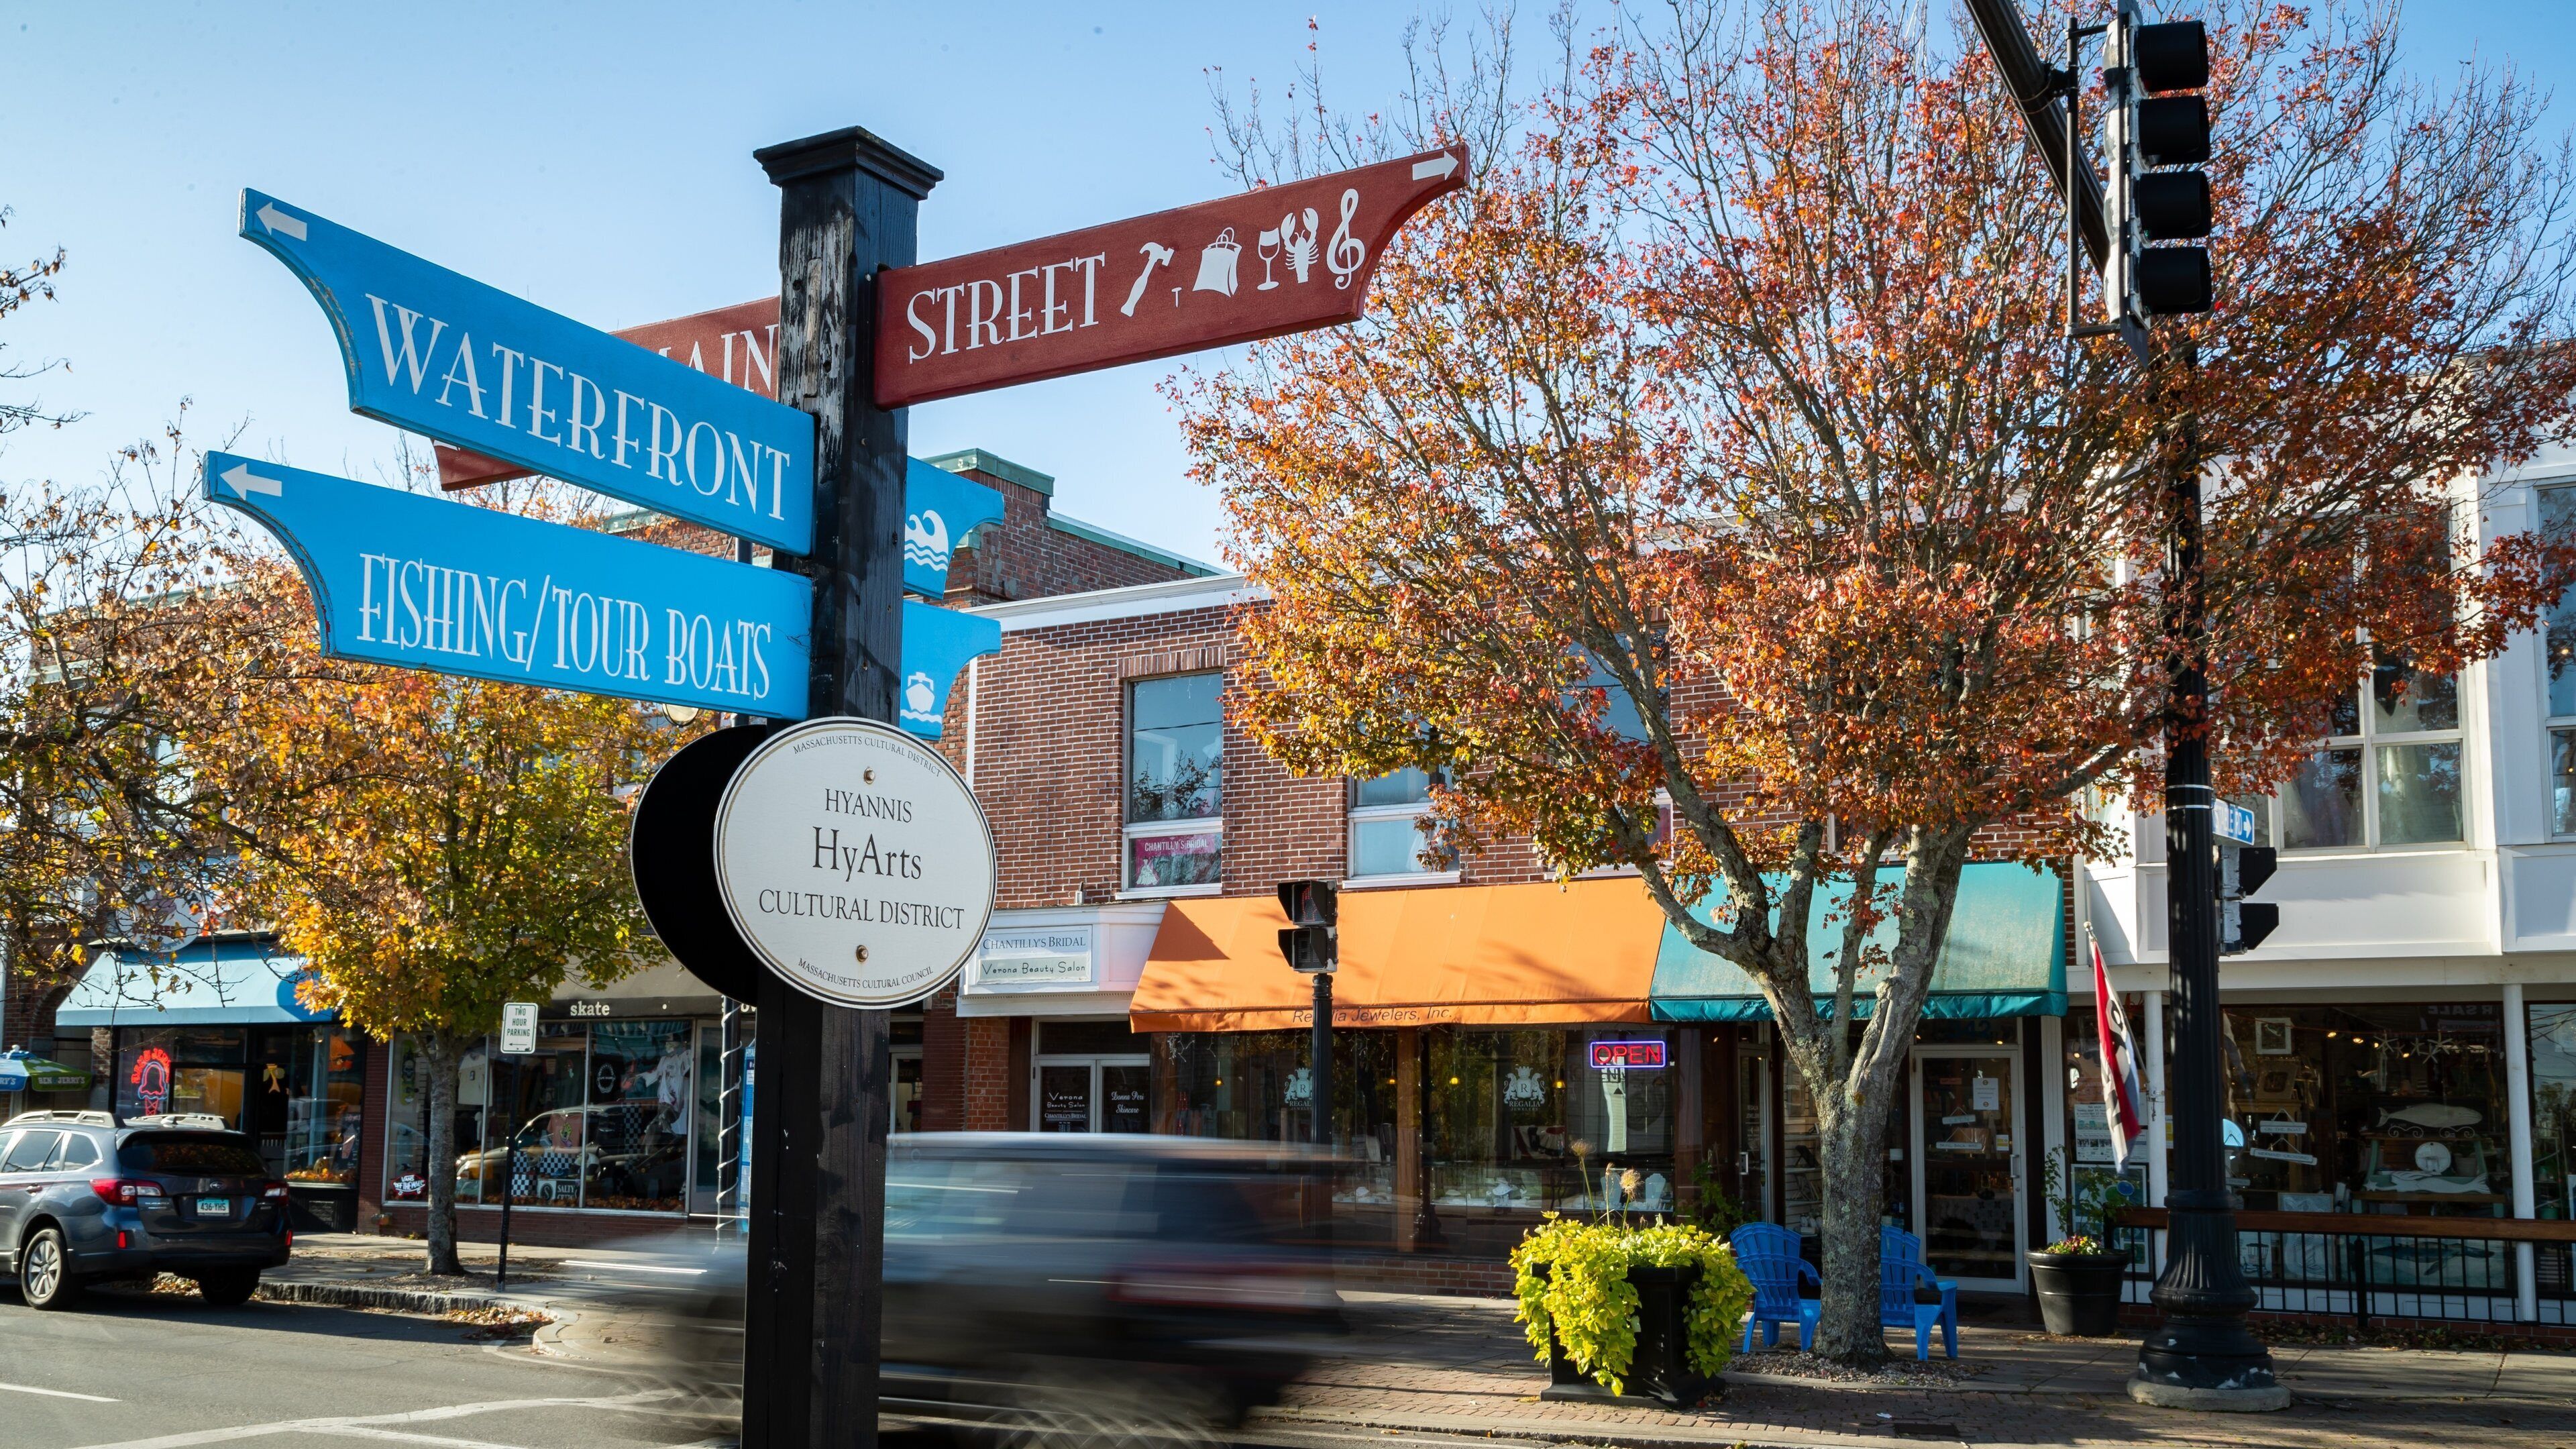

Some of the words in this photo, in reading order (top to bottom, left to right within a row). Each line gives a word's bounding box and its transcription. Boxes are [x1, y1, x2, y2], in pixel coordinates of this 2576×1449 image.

[908, 252, 1105, 364] STREET
[658, 324, 779, 392] AIN
[365, 293, 790, 521] WATERFRONT
[357, 553, 650, 681] FISHING/TOUR
[664, 608, 771, 700] BOATS
[794, 735, 863, 755] MASSACHUSETTS
[864, 737, 906, 757] CULTURAL
[907, 751, 942, 777] DISTRICT
[824, 788, 912, 823] HYANNIS
[1144, 839, 1185, 851] CHANTILLY'S
[1186, 839, 1208, 849] BRIDAL
[812, 826, 922, 882] HyArts
[759, 889, 874, 922] CULTURAL
[879, 900, 965, 929] DISTRICT
[983, 938, 1046, 950] CHANTILLY'S
[1049, 936, 1086, 947] BRIDAL
[798, 957, 861, 988] MASSACHUSETTS
[862, 977, 900, 989] CULTURAL
[902, 966, 933, 985] COUNCIL
[981, 963, 1018, 975] Verona
[1022, 962, 1054, 973] Beauty
[1058, 961, 1086, 973] Salon
[515, 1008, 526, 1016] TWO
[570, 1001, 610, 1016] skate
[1292, 1009, 1346, 1023] Relia
[1352, 1008, 1421, 1022] Jewelers,
[1427, 1006, 1452, 1019] Inc.
[512, 1018, 527, 1027] HOUR
[506, 1028, 531, 1037] PARKING
[1594, 1044, 1661, 1064] OPEN
[1300, 1084, 1307, 1093] R
[1521, 1083, 1528, 1093] R
[1049, 1092, 1083, 1101] Verona
[1116, 1104, 1139, 1114] Skincare
[557, 1185, 574, 1193] SALTY
